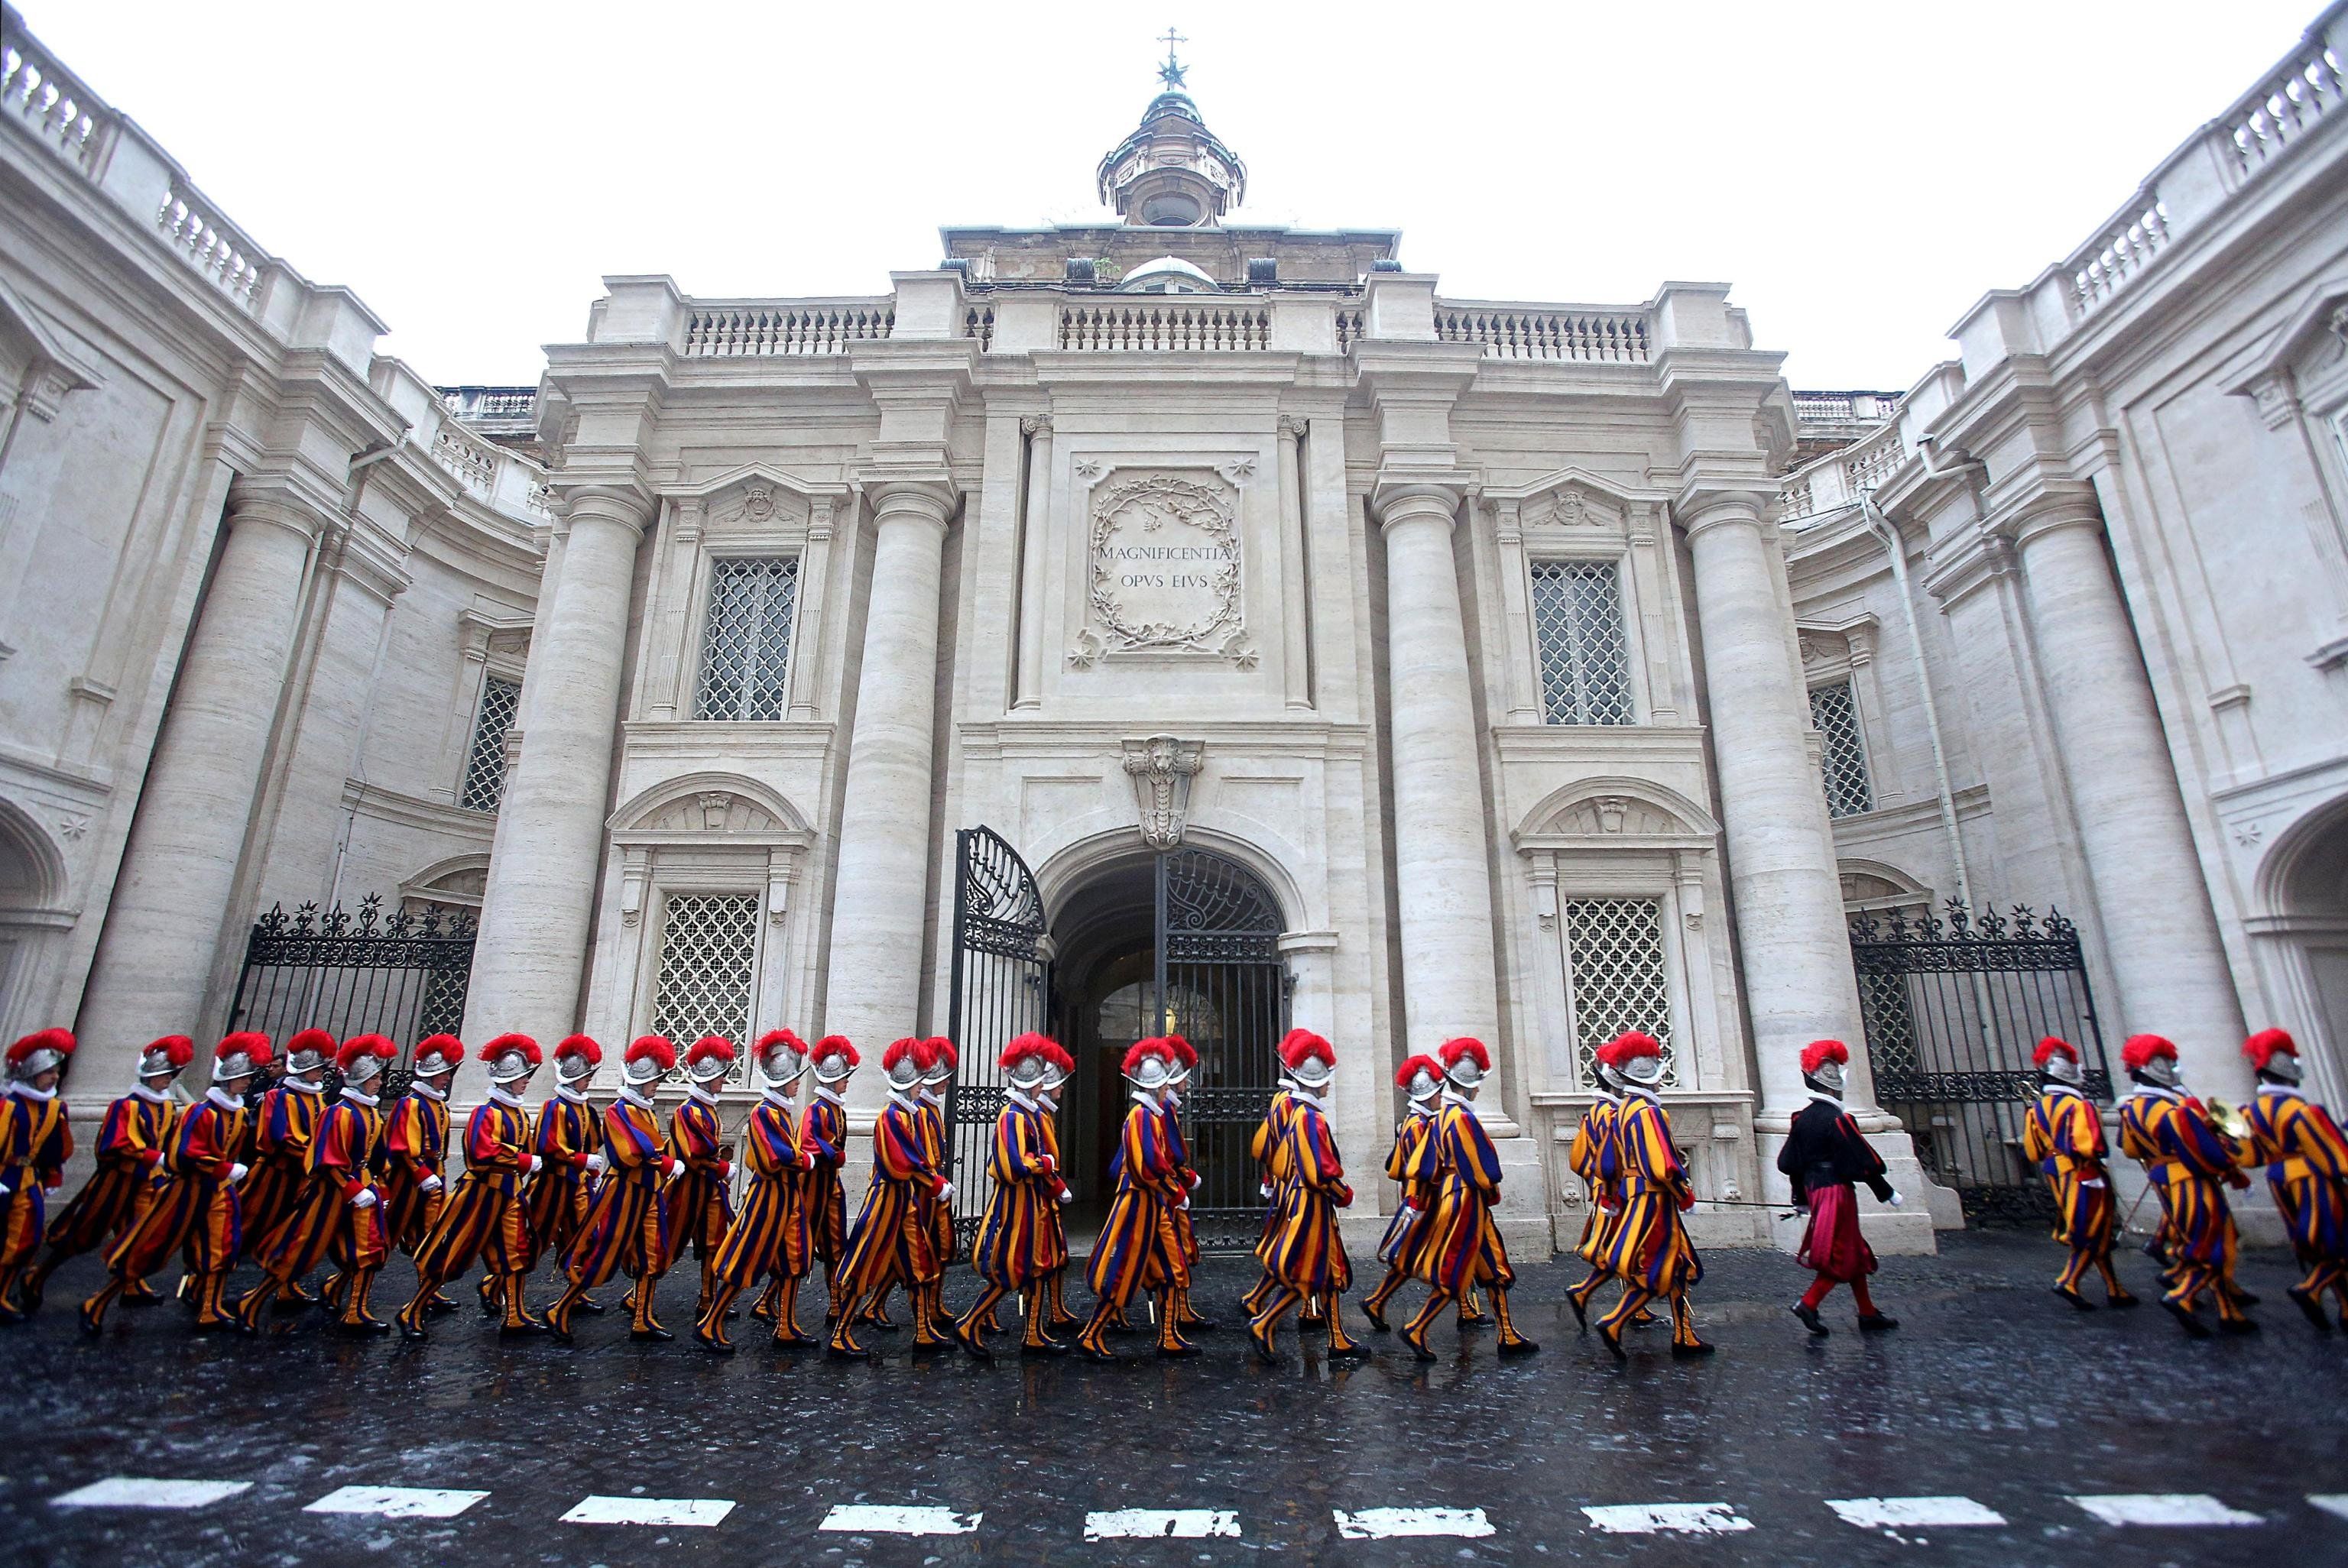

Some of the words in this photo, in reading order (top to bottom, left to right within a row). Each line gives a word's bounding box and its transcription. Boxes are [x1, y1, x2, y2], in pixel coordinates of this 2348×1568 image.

[1100, 547, 1231, 559] MAGNIFICENTIA
[1121, 575, 1163, 588] OPVS
[1172, 575, 1208, 588] EIVS
